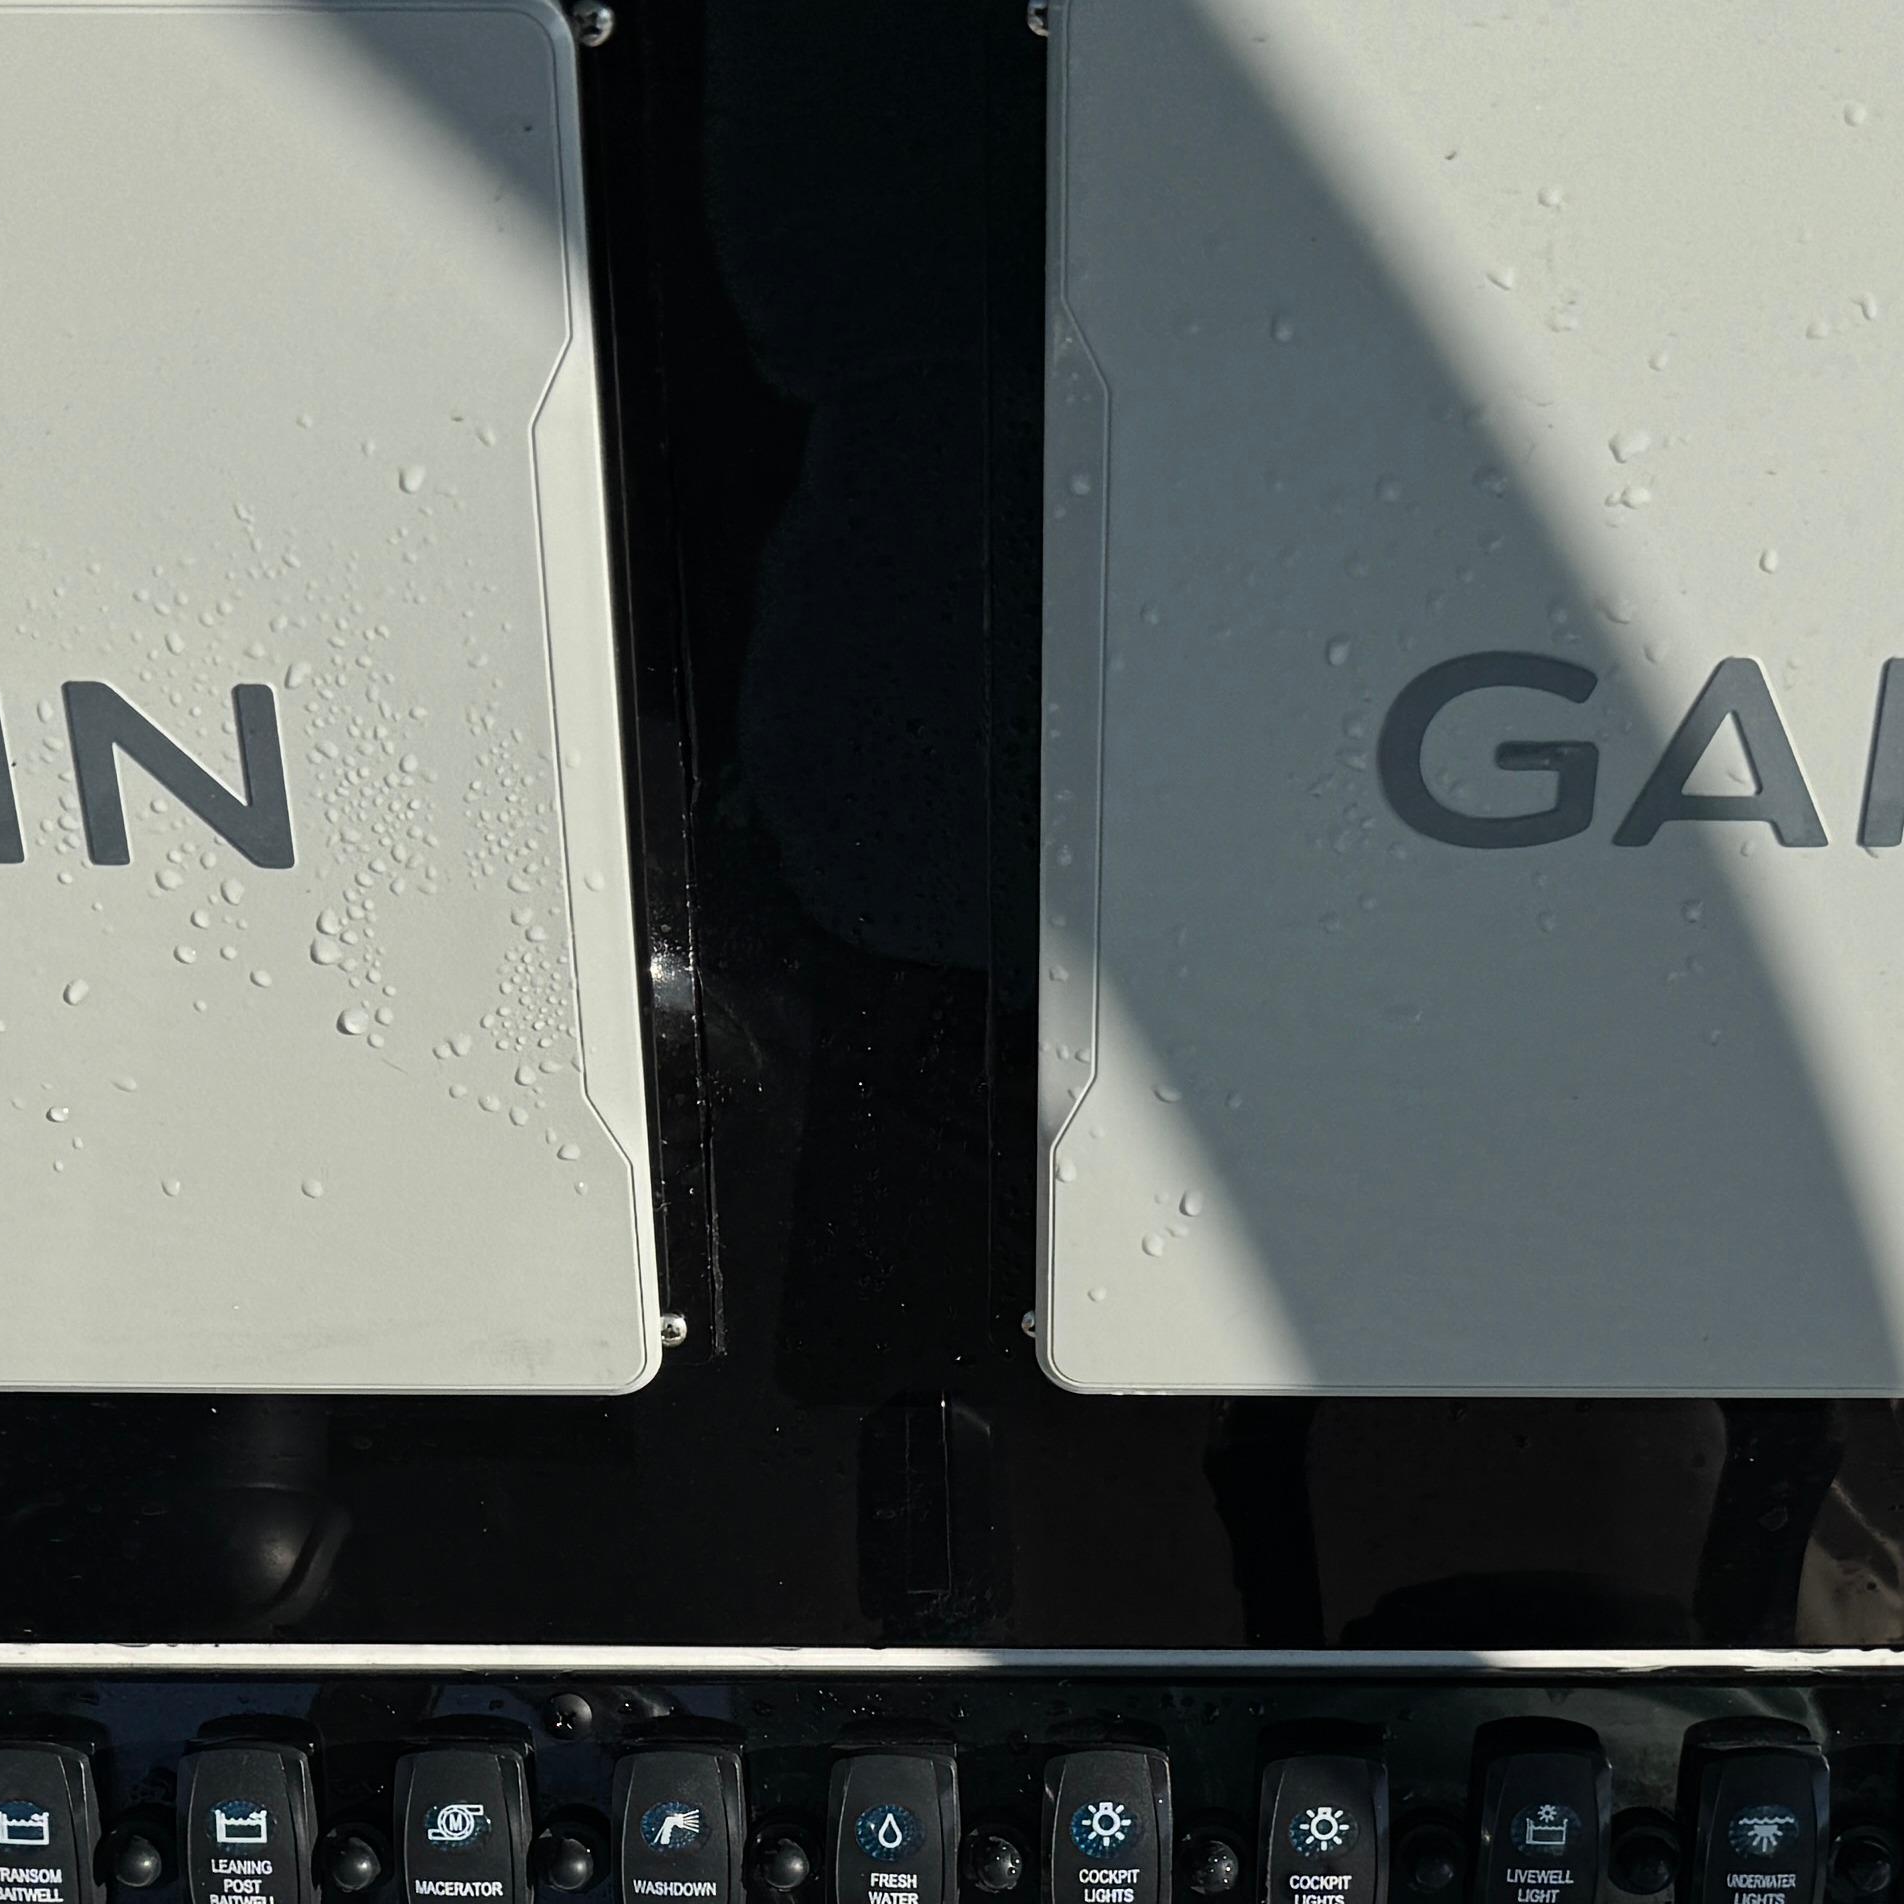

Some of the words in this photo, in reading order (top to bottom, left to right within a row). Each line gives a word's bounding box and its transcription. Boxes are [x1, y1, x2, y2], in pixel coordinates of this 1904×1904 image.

[211, 1859, 272, 1875] LEANING
[870, 1873, 918, 1889] FRESH
[1078, 1869, 1140, 1884] COCKPIT
[1289, 1875, 1352, 1891] COCKPIT
[1506, 1869, 1574, 1884] LIVEWELL
[1727, 1873, 1796, 1889] UNDERWATER
[223, 1878, 262, 1895] POST
[415, 1879, 503, 1897] MACERATOR
[633, 1879, 717, 1897] WASHDOWN
[1084, 1888, 1134, 1903] LIGHTS
[1517, 1888, 1560, 1904] LIGHT
